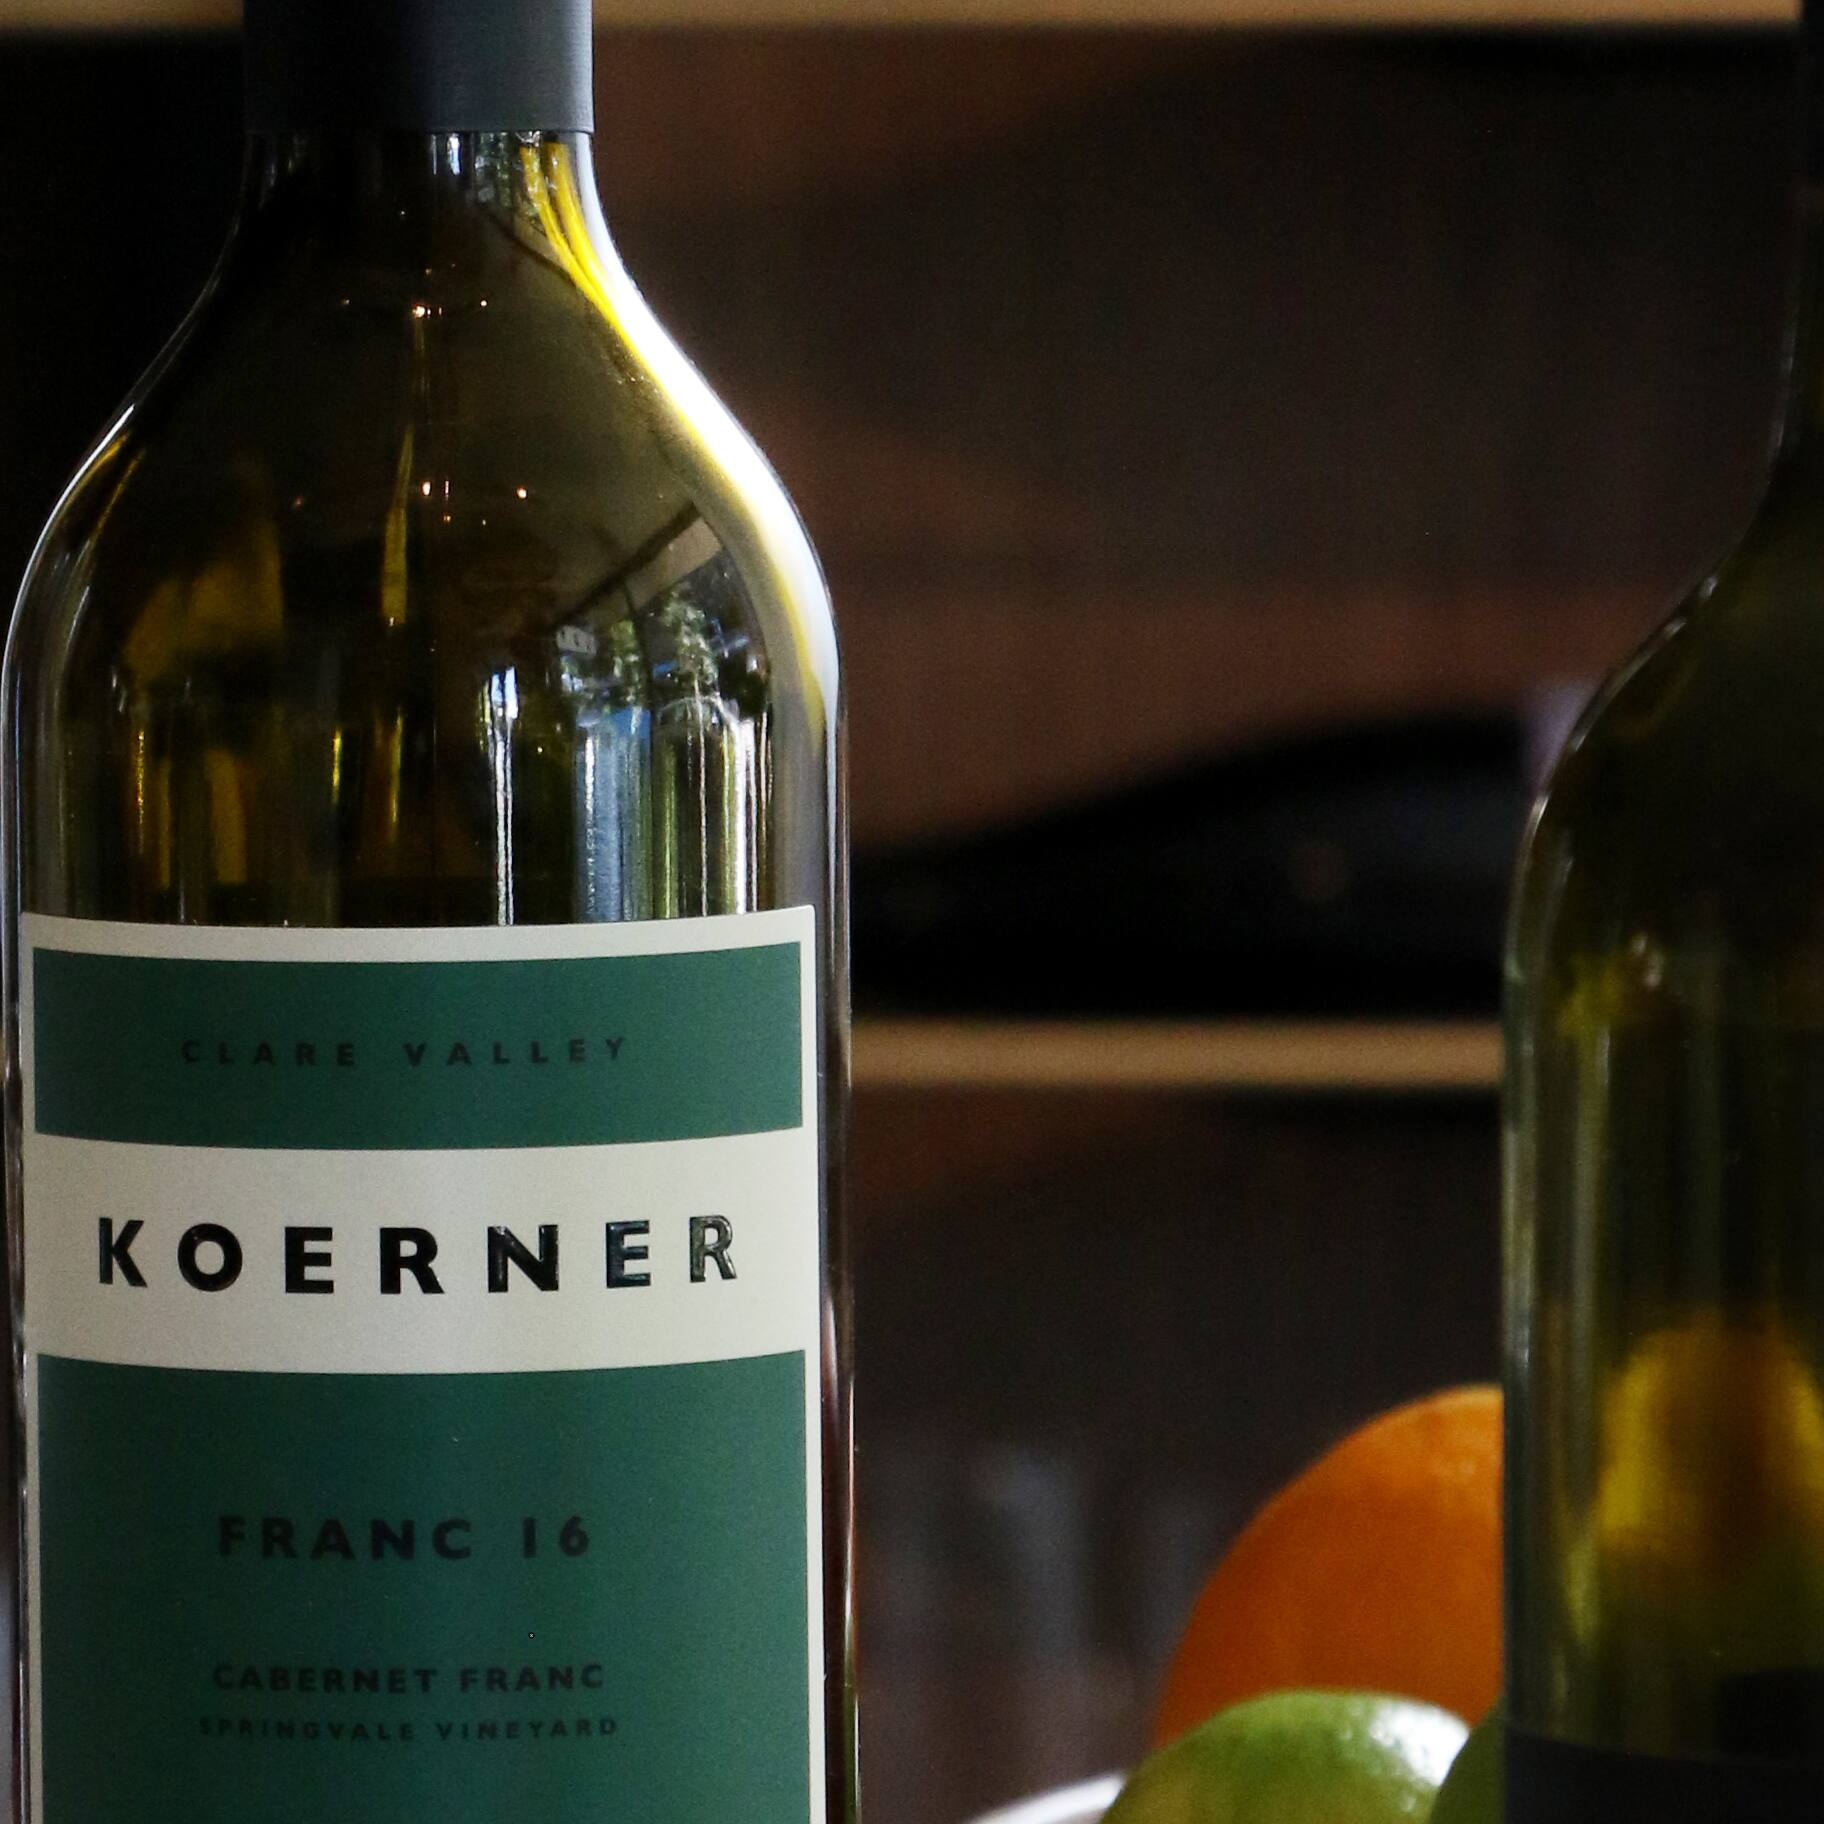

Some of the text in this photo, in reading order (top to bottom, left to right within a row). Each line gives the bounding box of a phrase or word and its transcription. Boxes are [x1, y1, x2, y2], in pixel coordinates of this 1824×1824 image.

[179, 1034, 629, 1068] CLARE VALLEY
[97, 1213, 738, 1296] KOERNER
[217, 1514, 592, 1561] FRANC 16
[211, 1662, 604, 1694] CABERNET FRANC
[198, 1715, 620, 1742] SPRINGVALE VINEYARD
